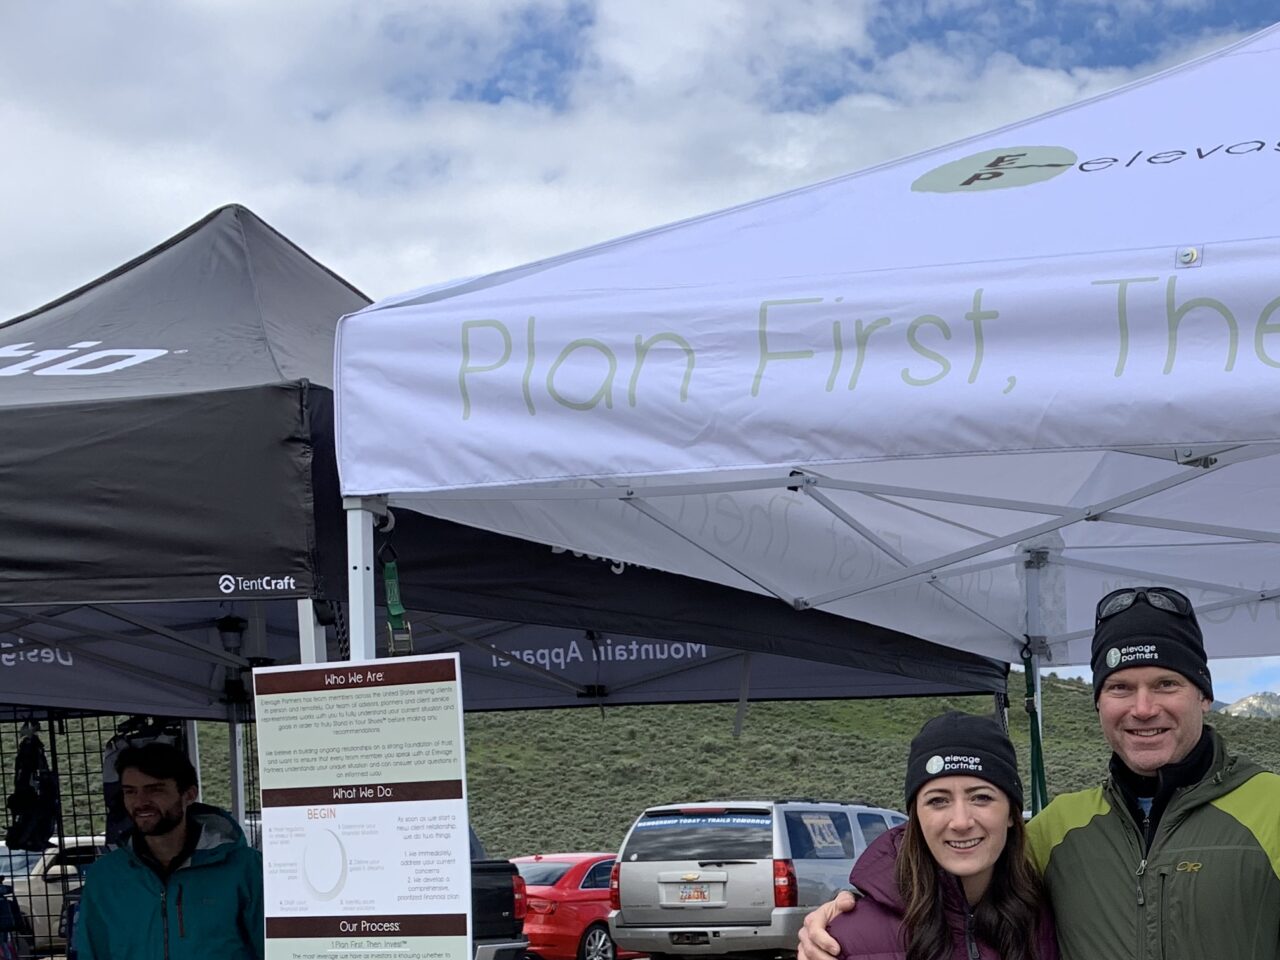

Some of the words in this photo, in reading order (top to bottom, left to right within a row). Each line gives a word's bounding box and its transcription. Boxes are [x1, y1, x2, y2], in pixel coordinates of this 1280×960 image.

[459, 316, 697, 421] Plan
[750, 287, 1017, 398] First,
[236, 575, 296, 591] TentCraft
[1121, 645, 1156, 654] elevage
[1121, 652, 1158, 663] partners
[324, 672, 345, 685] Who
[348, 671, 363, 684] We
[944, 754, 981, 764] elevage
[944, 762, 983, 771] partners
[332, 787, 355, 799] What
[359, 786, 374, 797] We
[307, 807, 336, 819] BEGIN
[339, 920, 357, 931] Our
[366, 940, 381, 948] Then
